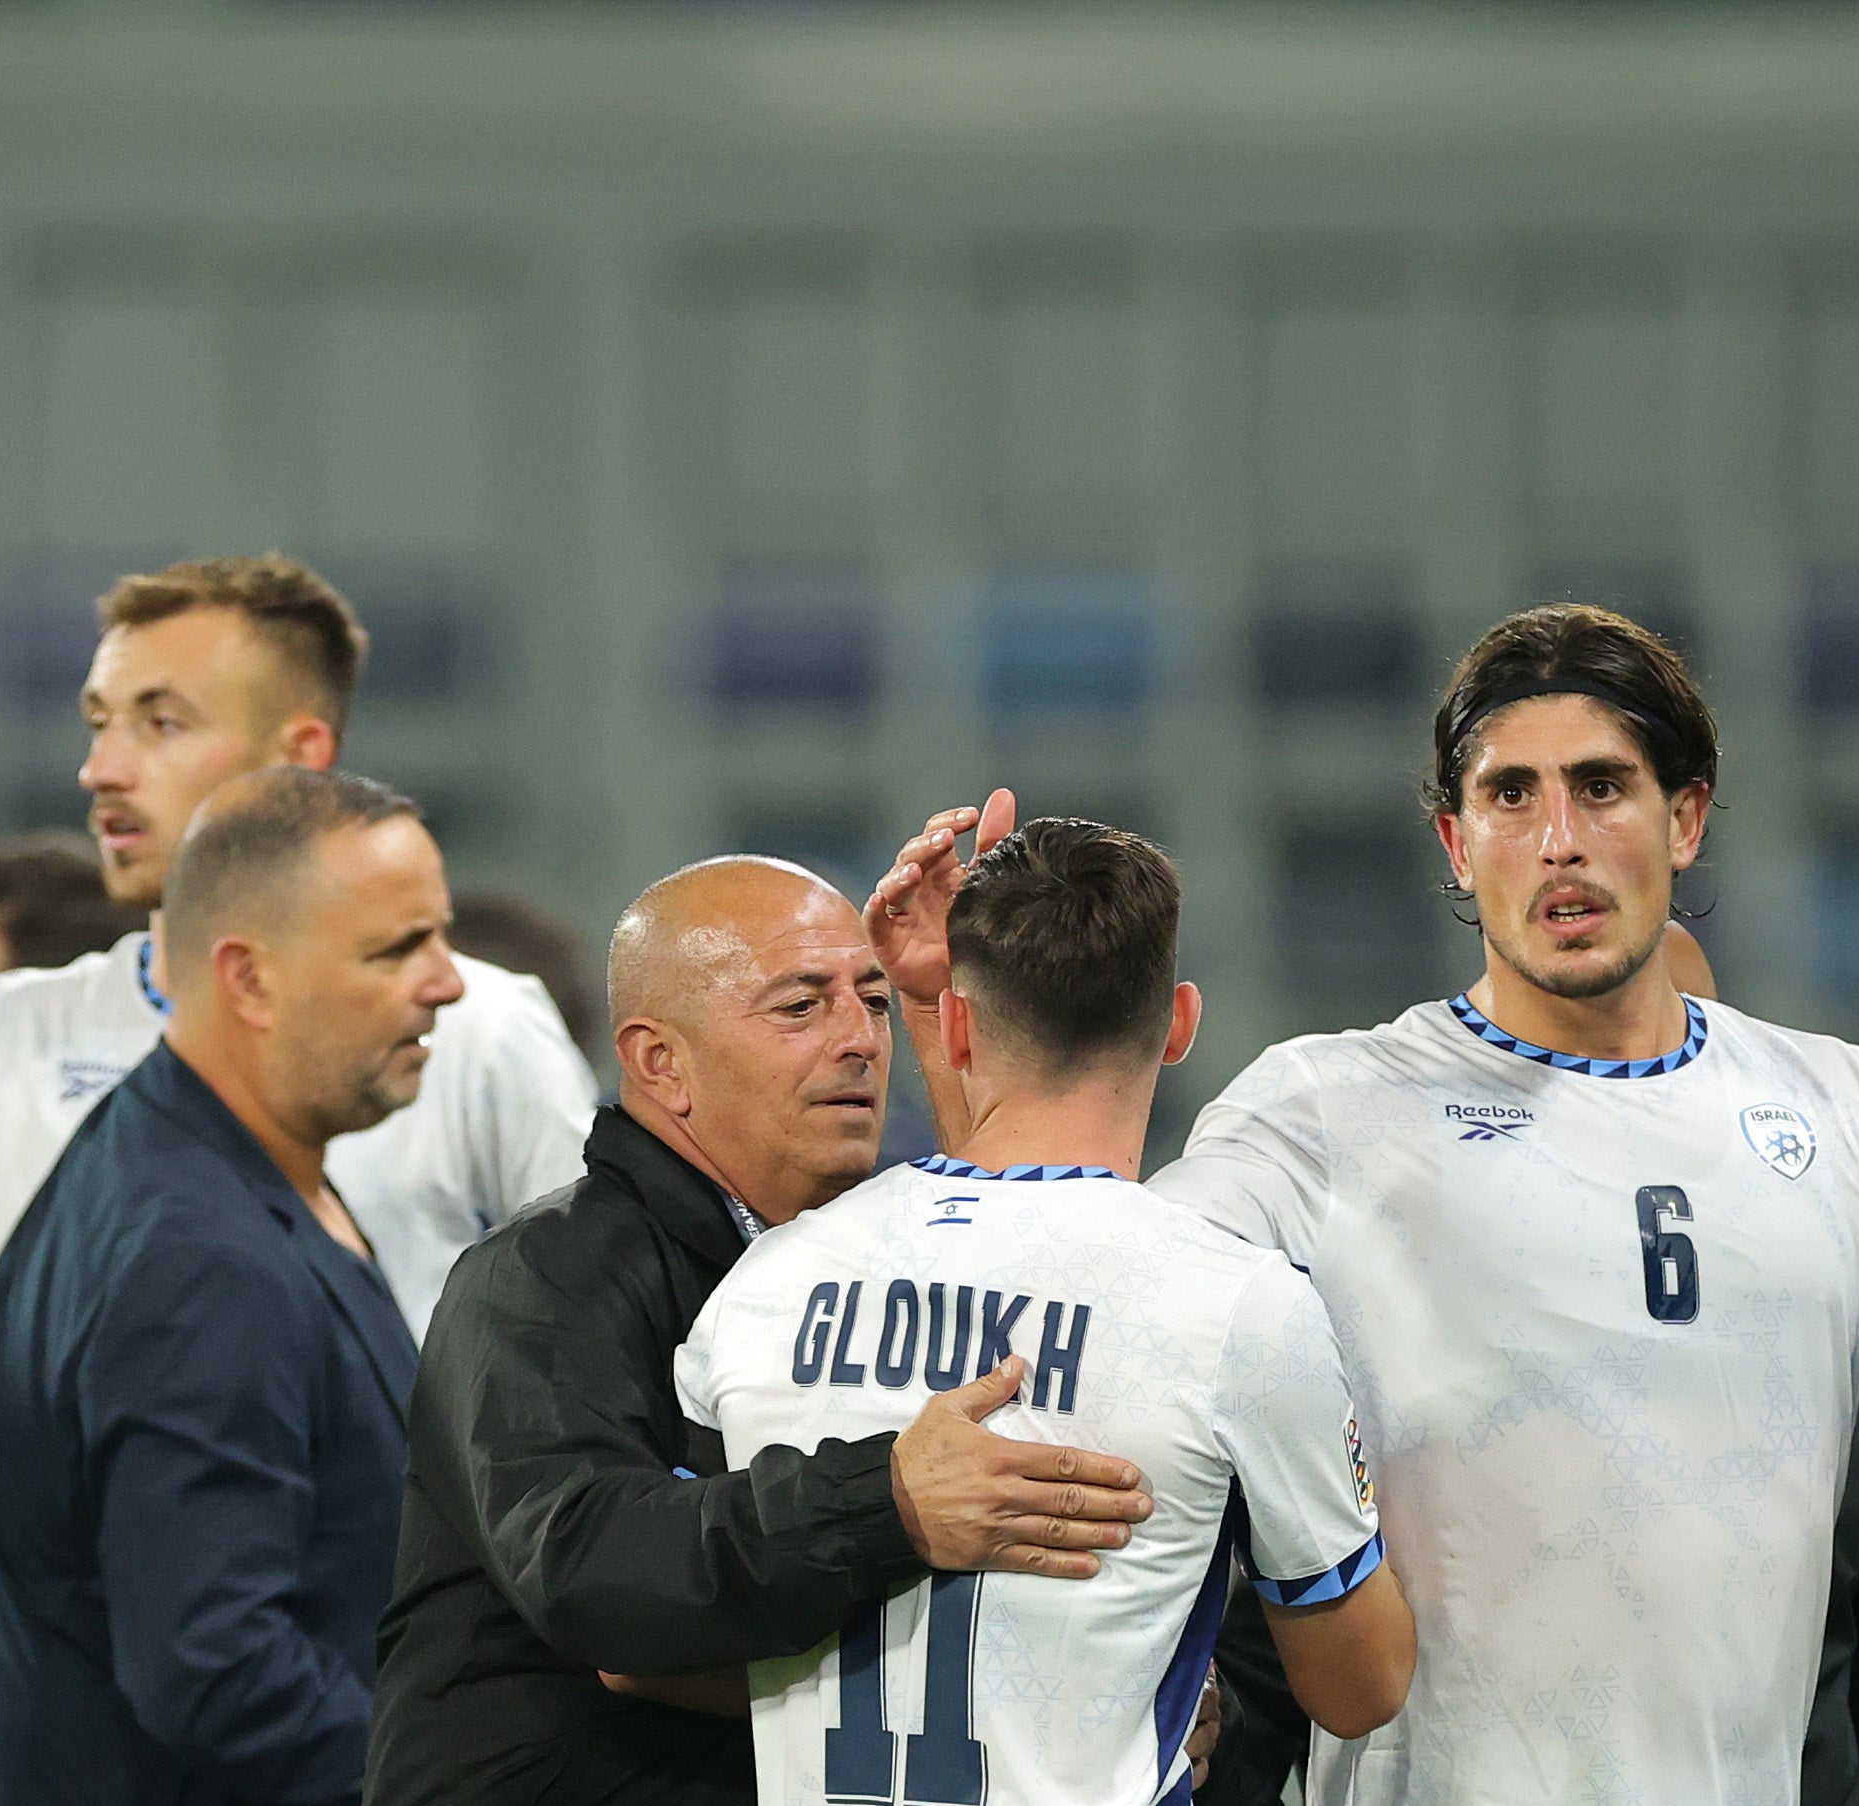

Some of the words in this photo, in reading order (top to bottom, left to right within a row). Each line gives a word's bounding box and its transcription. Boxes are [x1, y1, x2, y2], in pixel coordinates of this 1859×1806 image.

[1445, 1104, 1535, 1121] Reebok
[1750, 1110, 1798, 1123] ISRAEL
[1636, 1185, 1700, 1324] 6
[790, 1278, 1092, 1415] GLOUKH
